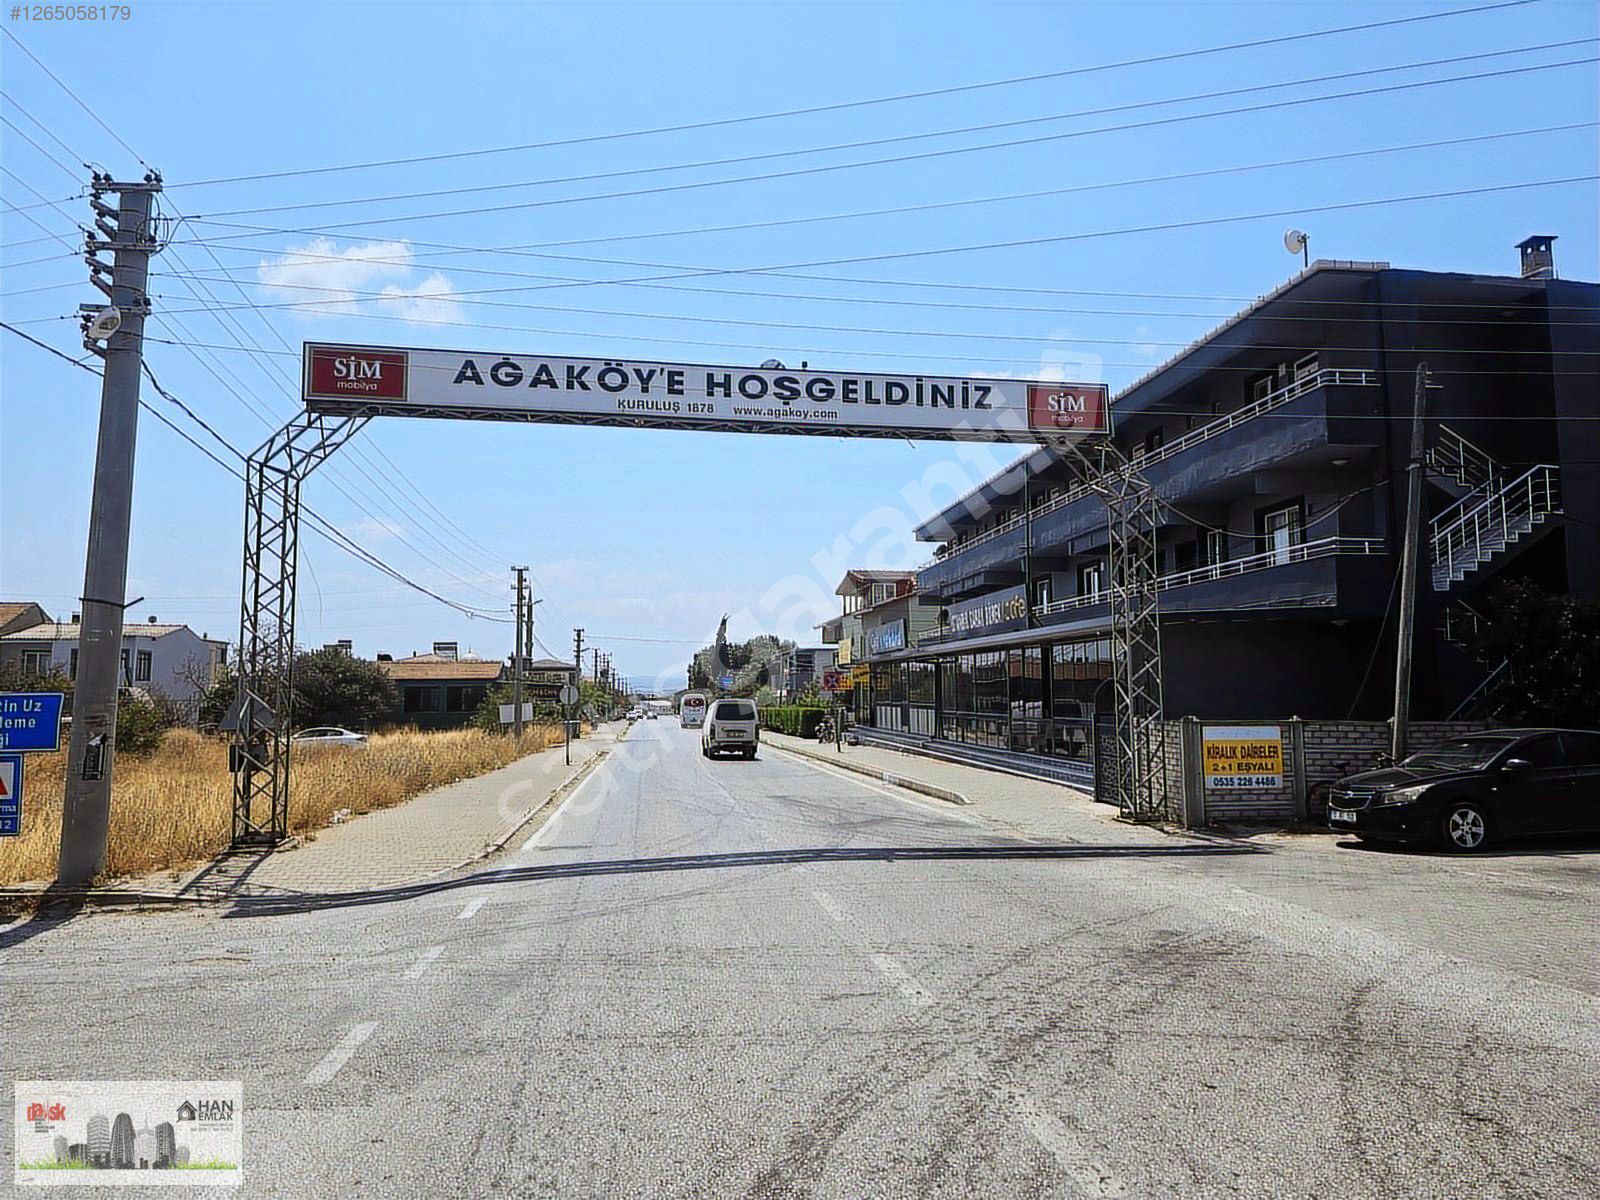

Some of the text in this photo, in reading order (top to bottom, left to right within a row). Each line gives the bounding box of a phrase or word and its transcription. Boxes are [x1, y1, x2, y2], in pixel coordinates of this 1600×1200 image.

[336, 380, 378, 391] mobilya
[453, 357, 993, 411] AĞAKÖY'E HOŞGELDİNİZ
[617, 399, 714, 414] KURULUŞ 1878
[733, 404, 839, 419] www.agakoy.com
[23, 698, 43, 712] Uz
[1206, 742, 1280, 760] KİRALIK DAİRELER
[1212, 762, 1233, 772] 2+1
